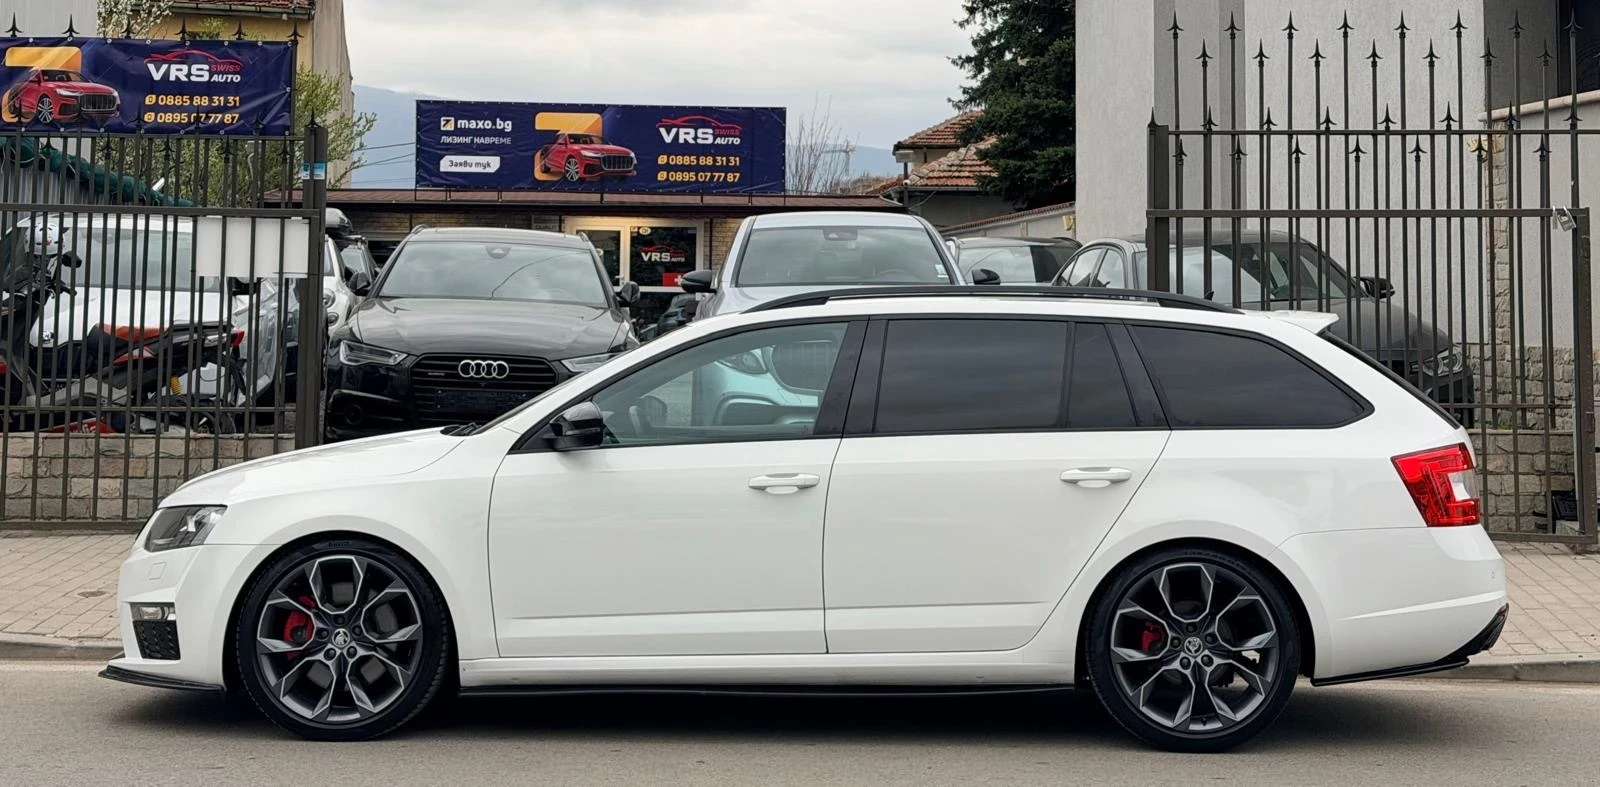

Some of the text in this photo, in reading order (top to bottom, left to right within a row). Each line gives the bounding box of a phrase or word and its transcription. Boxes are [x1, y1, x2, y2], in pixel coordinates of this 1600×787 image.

[147, 64, 210, 82] VRS
[210, 74, 241, 82] AUTO
[158, 95, 240, 107] 0885 88 31 31
[157, 112, 188, 123] 0895
[208, 114, 223, 123] 77
[224, 114, 240, 123] 87
[457, 118, 512, 132] maxo.bg
[440, 136, 512, 145] ЛИЗИНГ НАВРЕМЕ
[658, 127, 713, 144] VRS
[448, 160, 472, 168] Заяви
[669, 156, 740, 166] 0885 88 31 31
[668, 172, 740, 182] 0895 07 77 87
[640, 252, 670, 262] VRS
